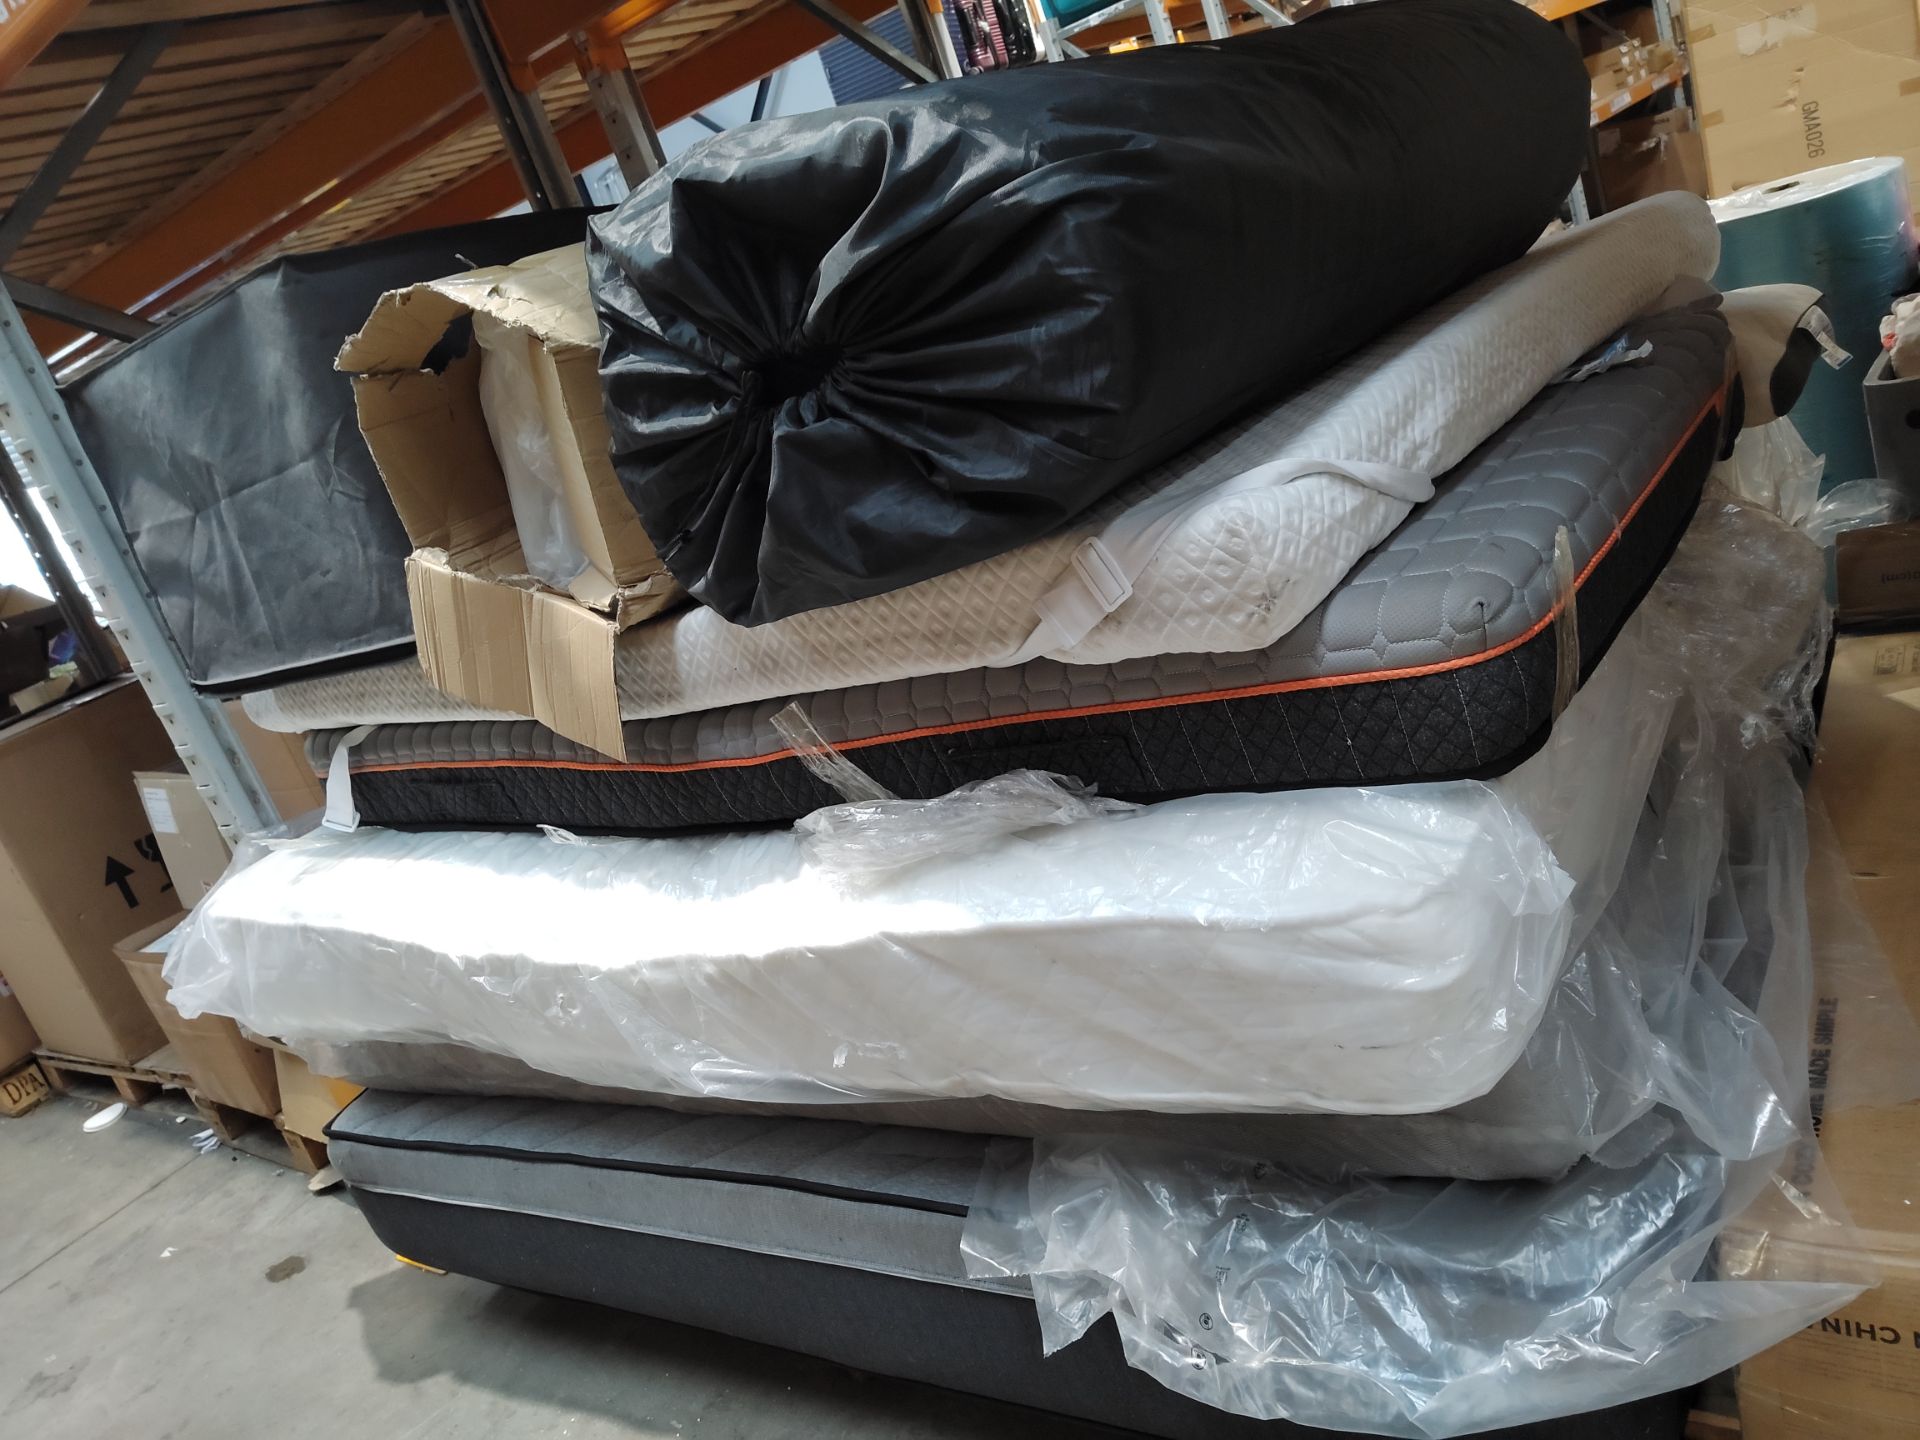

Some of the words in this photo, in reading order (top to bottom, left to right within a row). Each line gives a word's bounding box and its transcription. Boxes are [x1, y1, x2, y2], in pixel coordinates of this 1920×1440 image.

[1802, 101, 1825, 159] GMA026
[1813, 997, 1838, 1045] SIMPLE
[1808, 1048, 1831, 1088] MADE
[1806, 1318, 1901, 1345] CHIN
